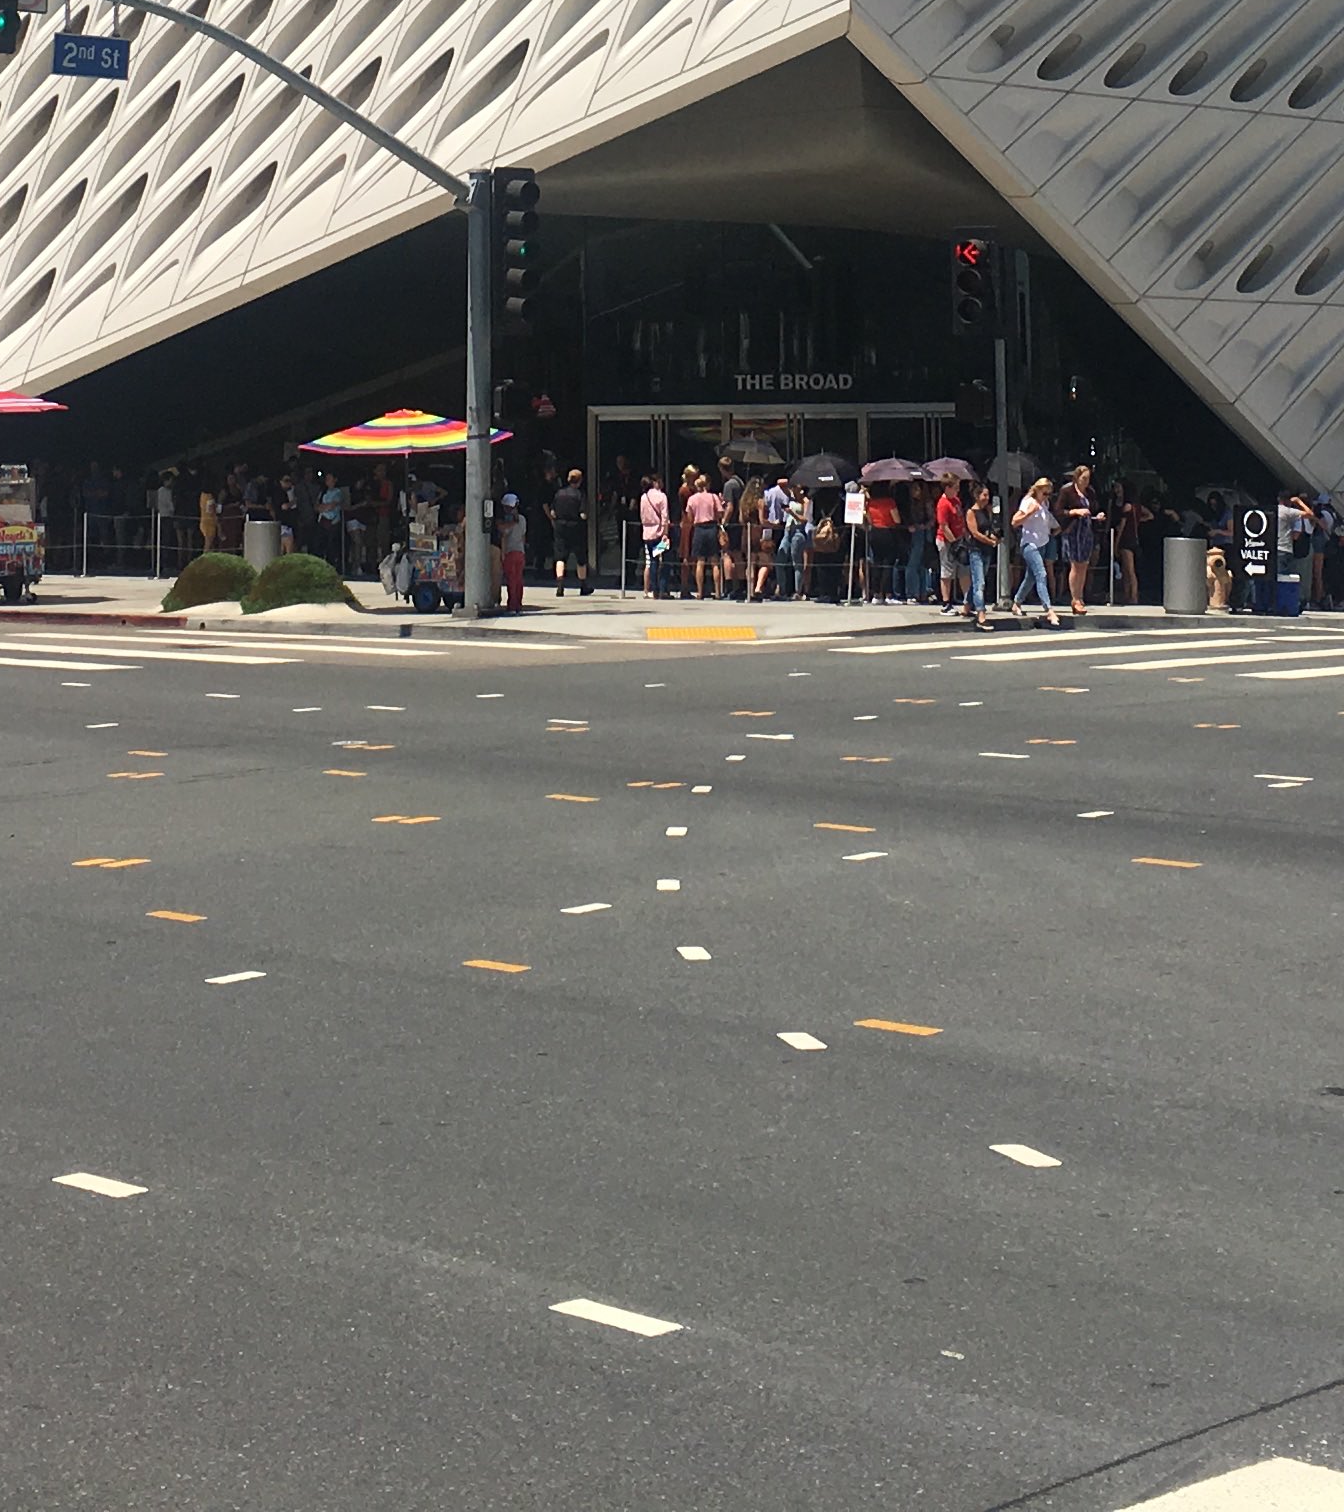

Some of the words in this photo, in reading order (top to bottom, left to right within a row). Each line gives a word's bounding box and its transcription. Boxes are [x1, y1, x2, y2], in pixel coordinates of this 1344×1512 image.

[62, 42, 96, 68] 2nd
[101, 47, 120, 69] St
[734, 374, 775, 390] THE
[780, 373, 853, 390] BROAD
[1240, 549, 1270, 561] VALET
